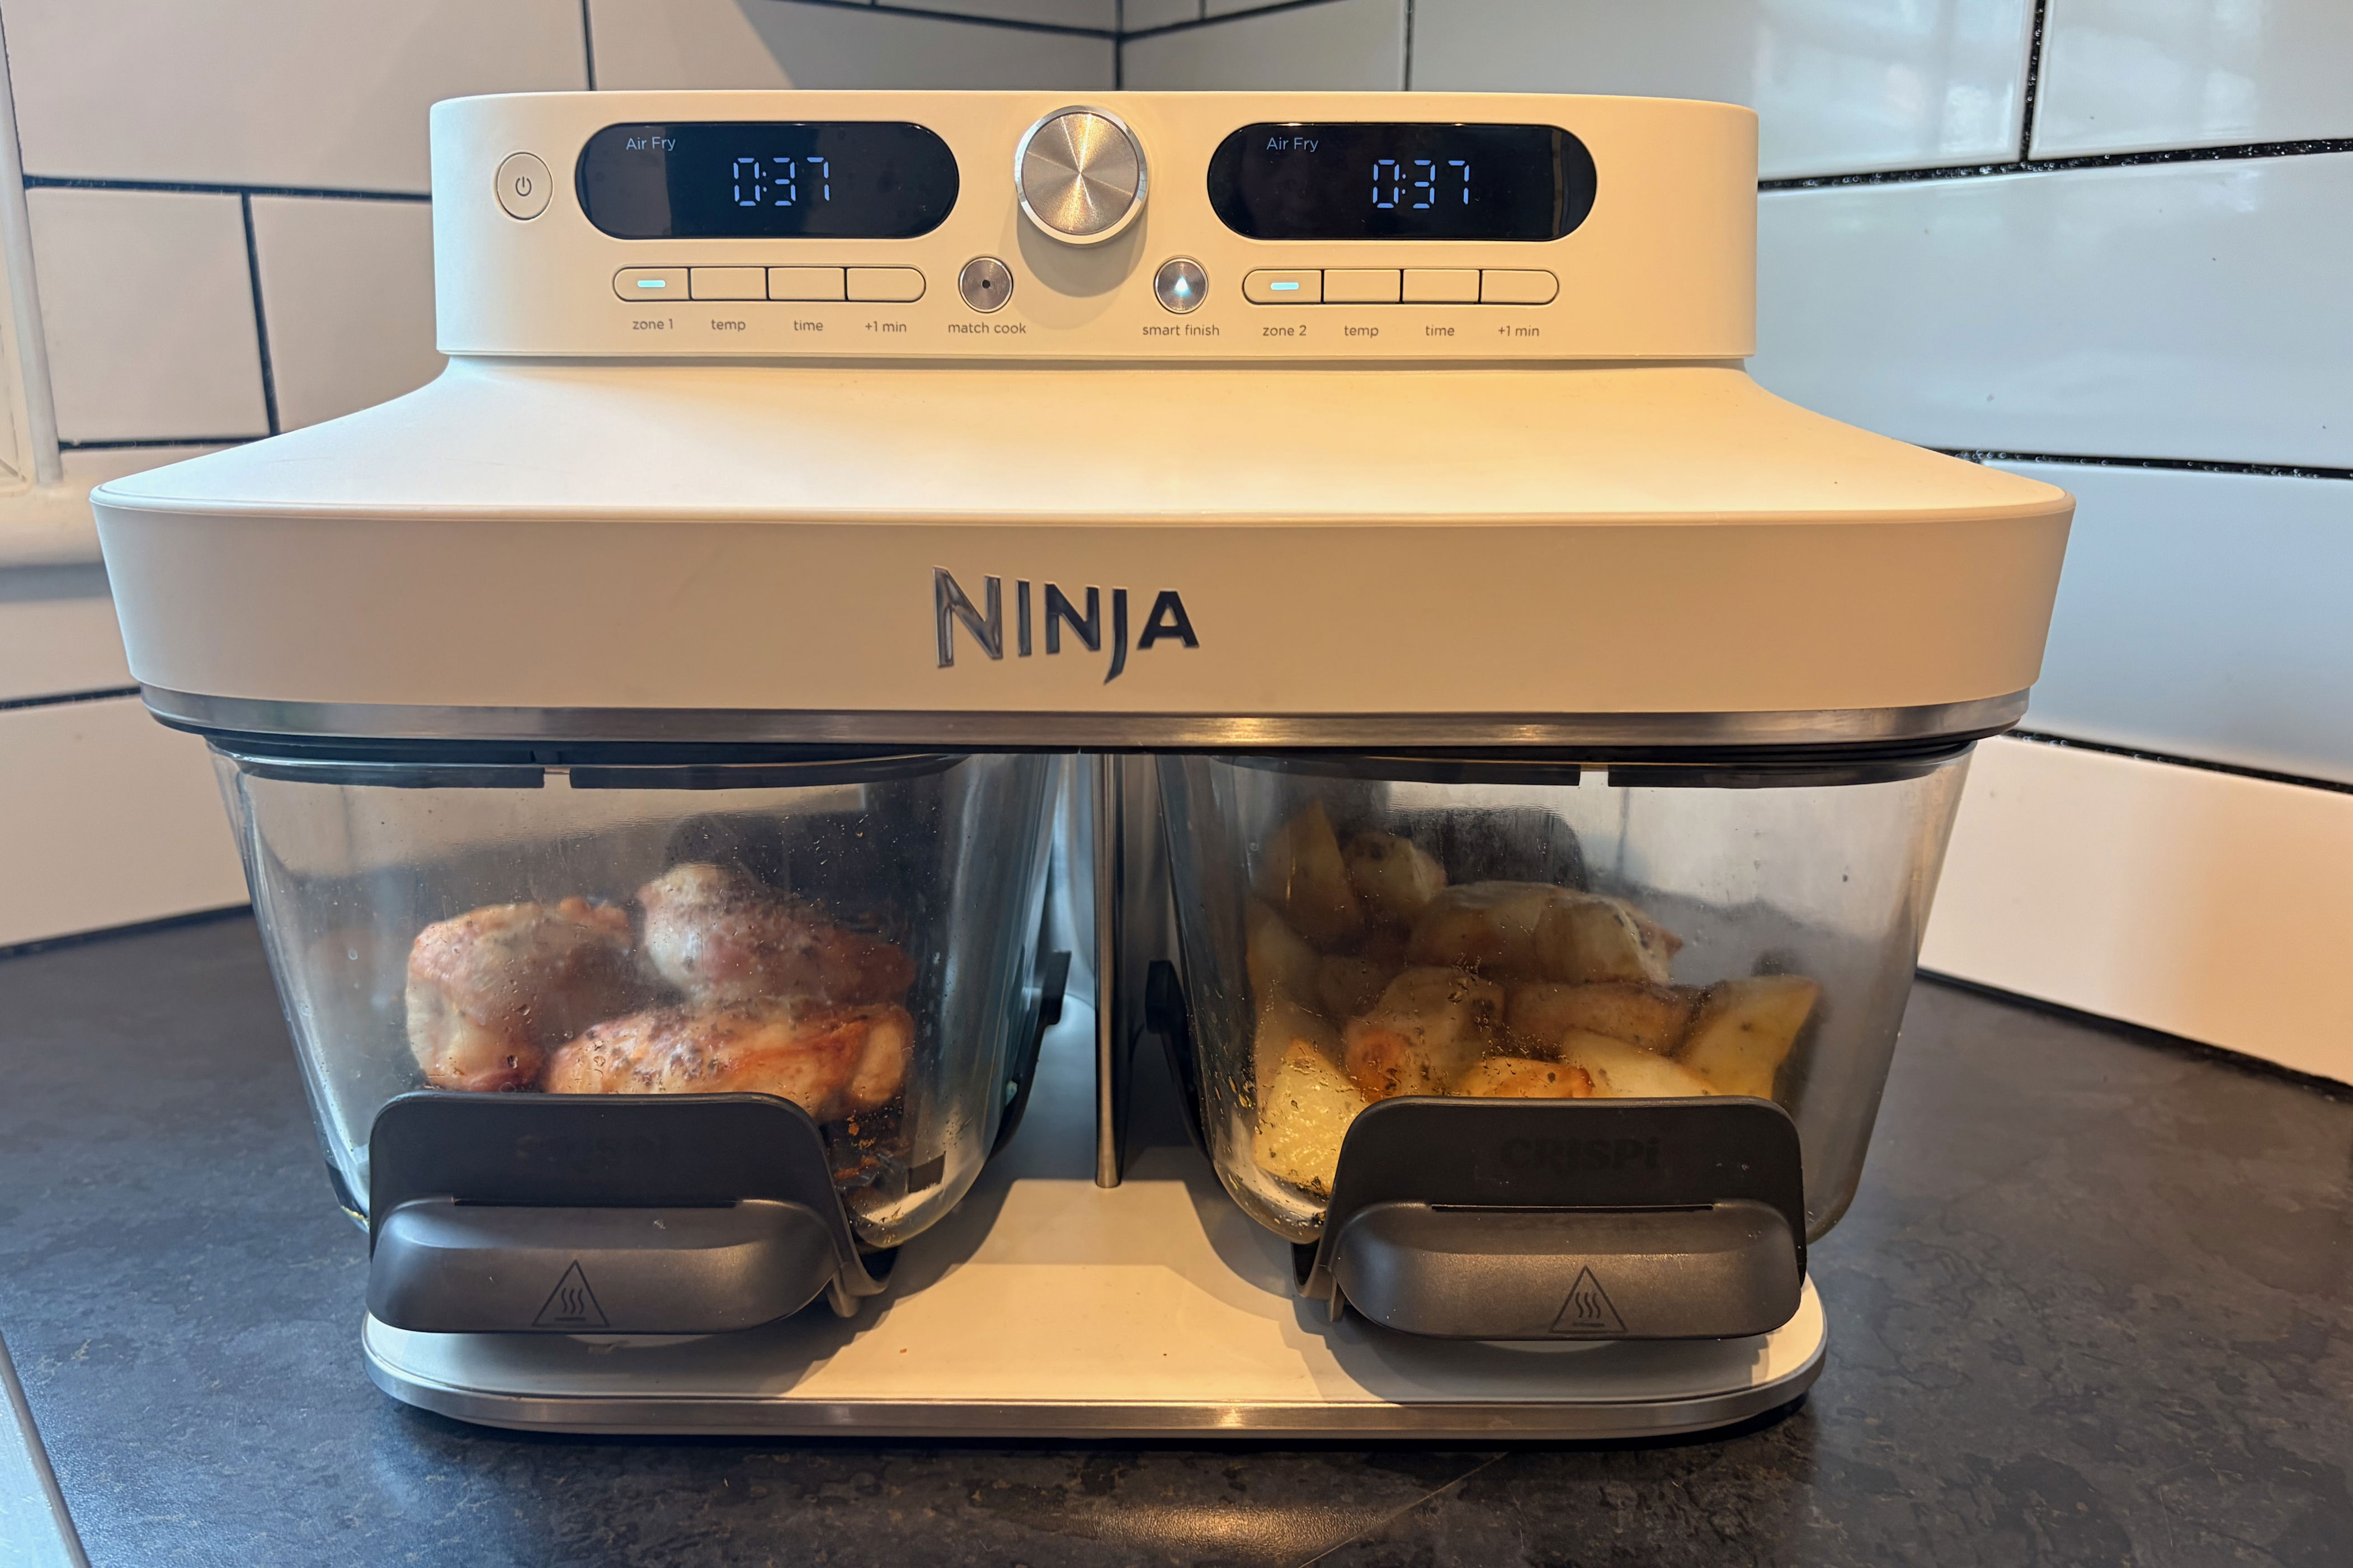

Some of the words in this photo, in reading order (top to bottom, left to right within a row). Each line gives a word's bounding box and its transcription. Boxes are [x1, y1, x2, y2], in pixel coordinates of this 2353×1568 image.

[625, 136, 648, 150] Air
[651, 136, 676, 152] Fry
[1266, 136, 1289, 150] Air
[1293, 137, 1319, 153] Fry
[732, 157, 831, 207] 0:37
[1372, 159, 1470, 209] 0:37
[632, 320, 664, 330] zone
[668, 318, 674, 330] 1
[710, 319, 747, 333] temp
[793, 319, 824, 332] time
[864, 320, 878, 332] +1
[882, 320, 908, 333] min
[947, 322, 989, 334] match
[993, 322, 1027, 335] cook
[1142, 324, 1180, 336] smart
[1185, 324, 1220, 336] finish
[1262, 326, 1295, 337] zone
[1298, 324, 1307, 337] 2
[1343, 325, 1380, 339] temp
[1425, 325, 1455, 337] time
[1498, 325, 1511, 337] +1
[1515, 325, 1540, 337] min
[932, 565, 1200, 686] NINJA
